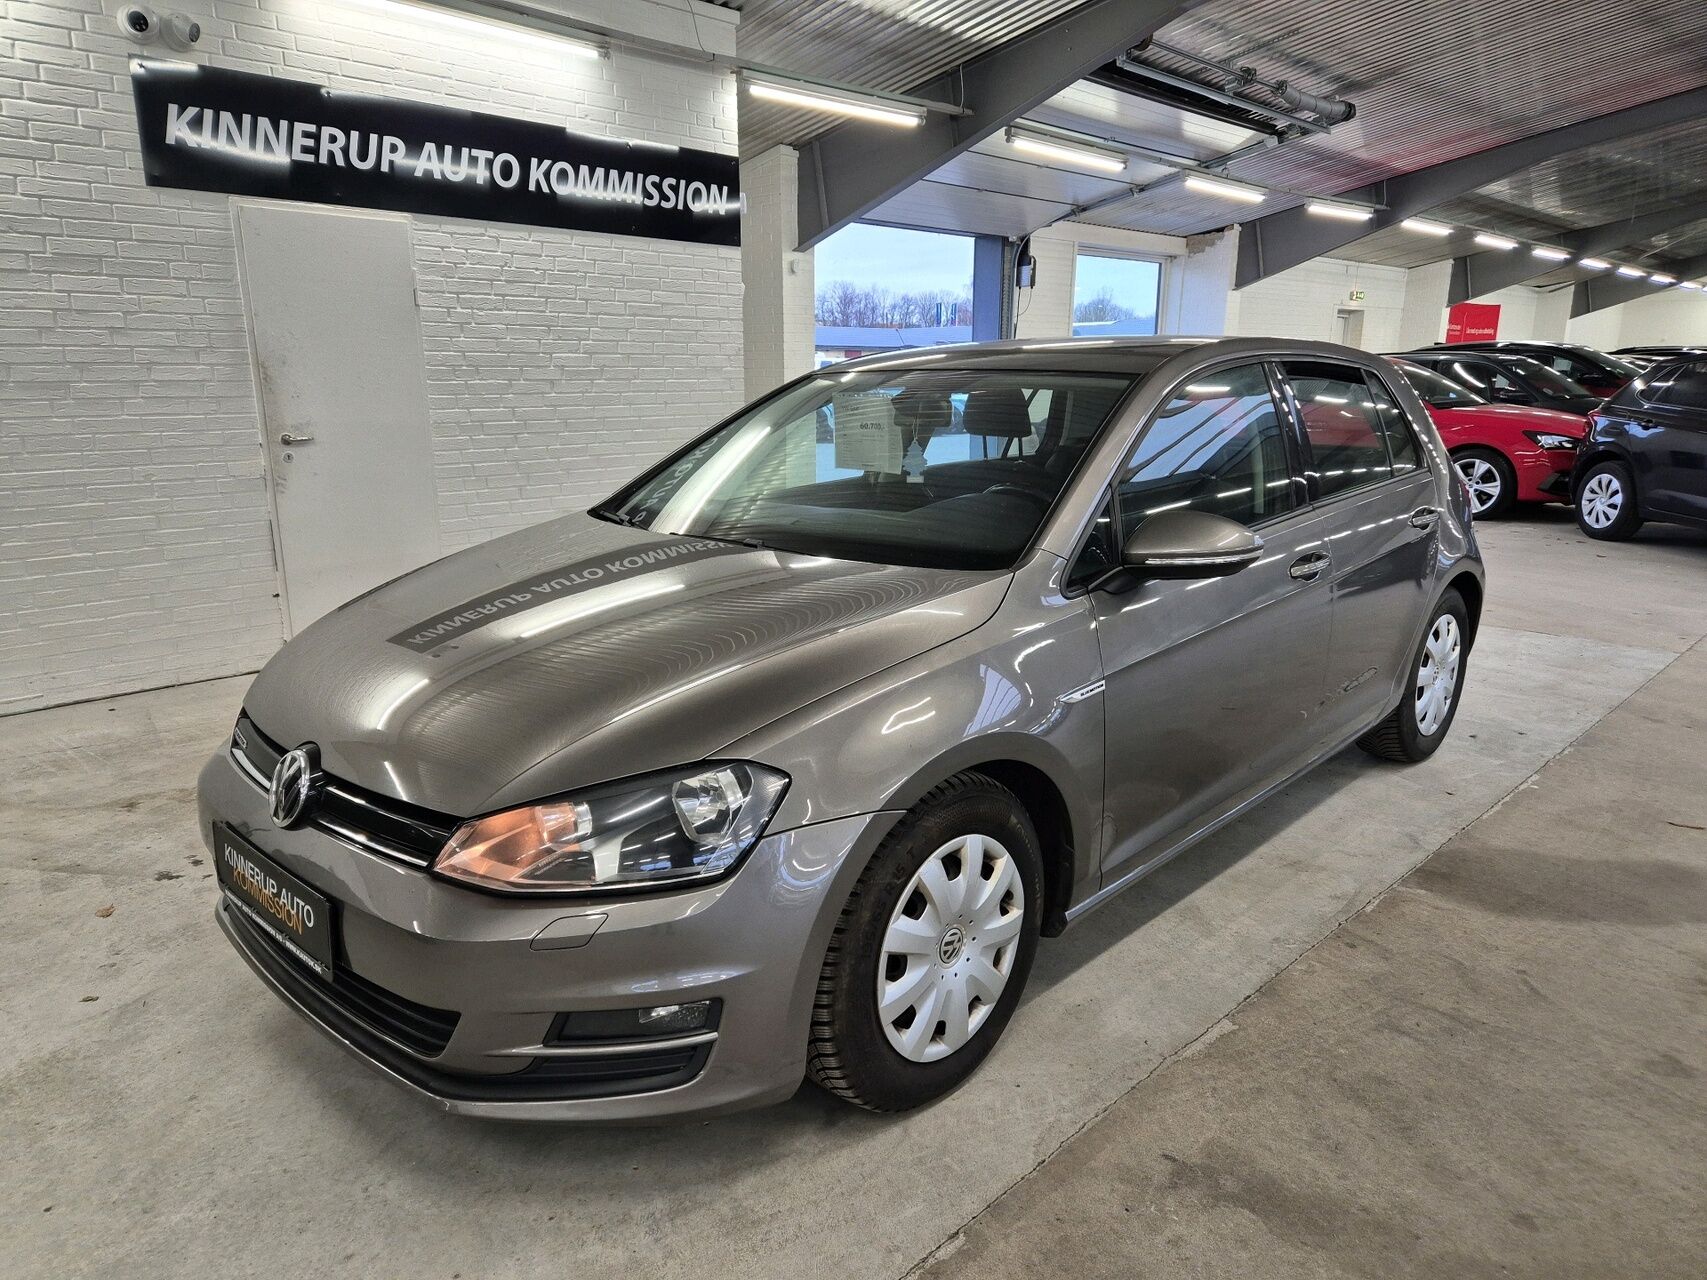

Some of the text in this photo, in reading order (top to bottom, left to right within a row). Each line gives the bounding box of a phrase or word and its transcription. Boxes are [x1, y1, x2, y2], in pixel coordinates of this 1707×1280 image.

[164, 102, 729, 216] KINNERUP AUTO KOMMISSION
[224, 843, 278, 898] KINNERUP
[279, 887, 315, 928] AUTO
